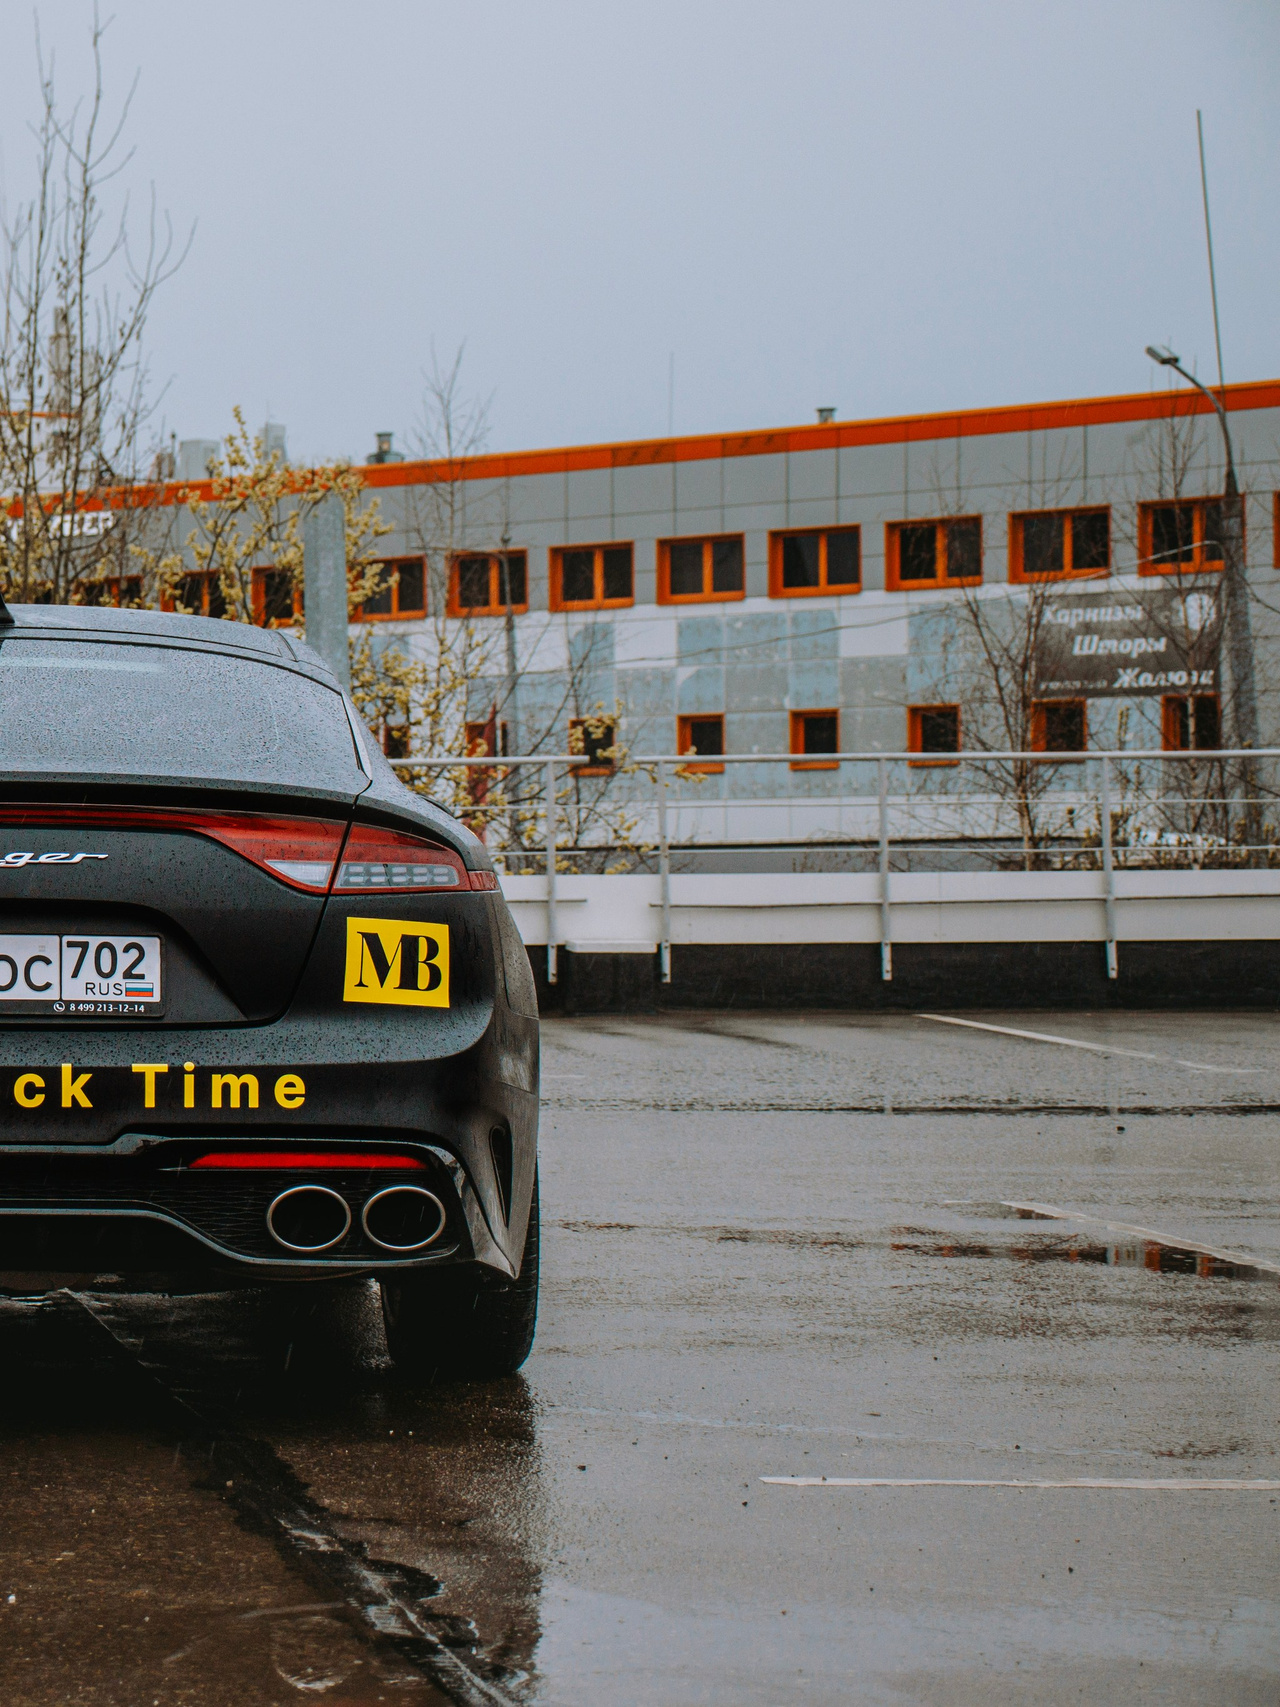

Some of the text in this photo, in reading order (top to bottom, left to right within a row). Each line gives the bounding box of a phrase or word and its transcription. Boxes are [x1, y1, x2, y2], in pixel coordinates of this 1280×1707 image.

[1072, 634, 1168, 659] Шторы
[66, 941, 147, 980] 702
[354, 931, 442, 992] MB
[85, 982, 123, 996] RUS
[69, 1003, 145, 1013] 8 499 213-12-14
[131, 1061, 306, 1109] Time
